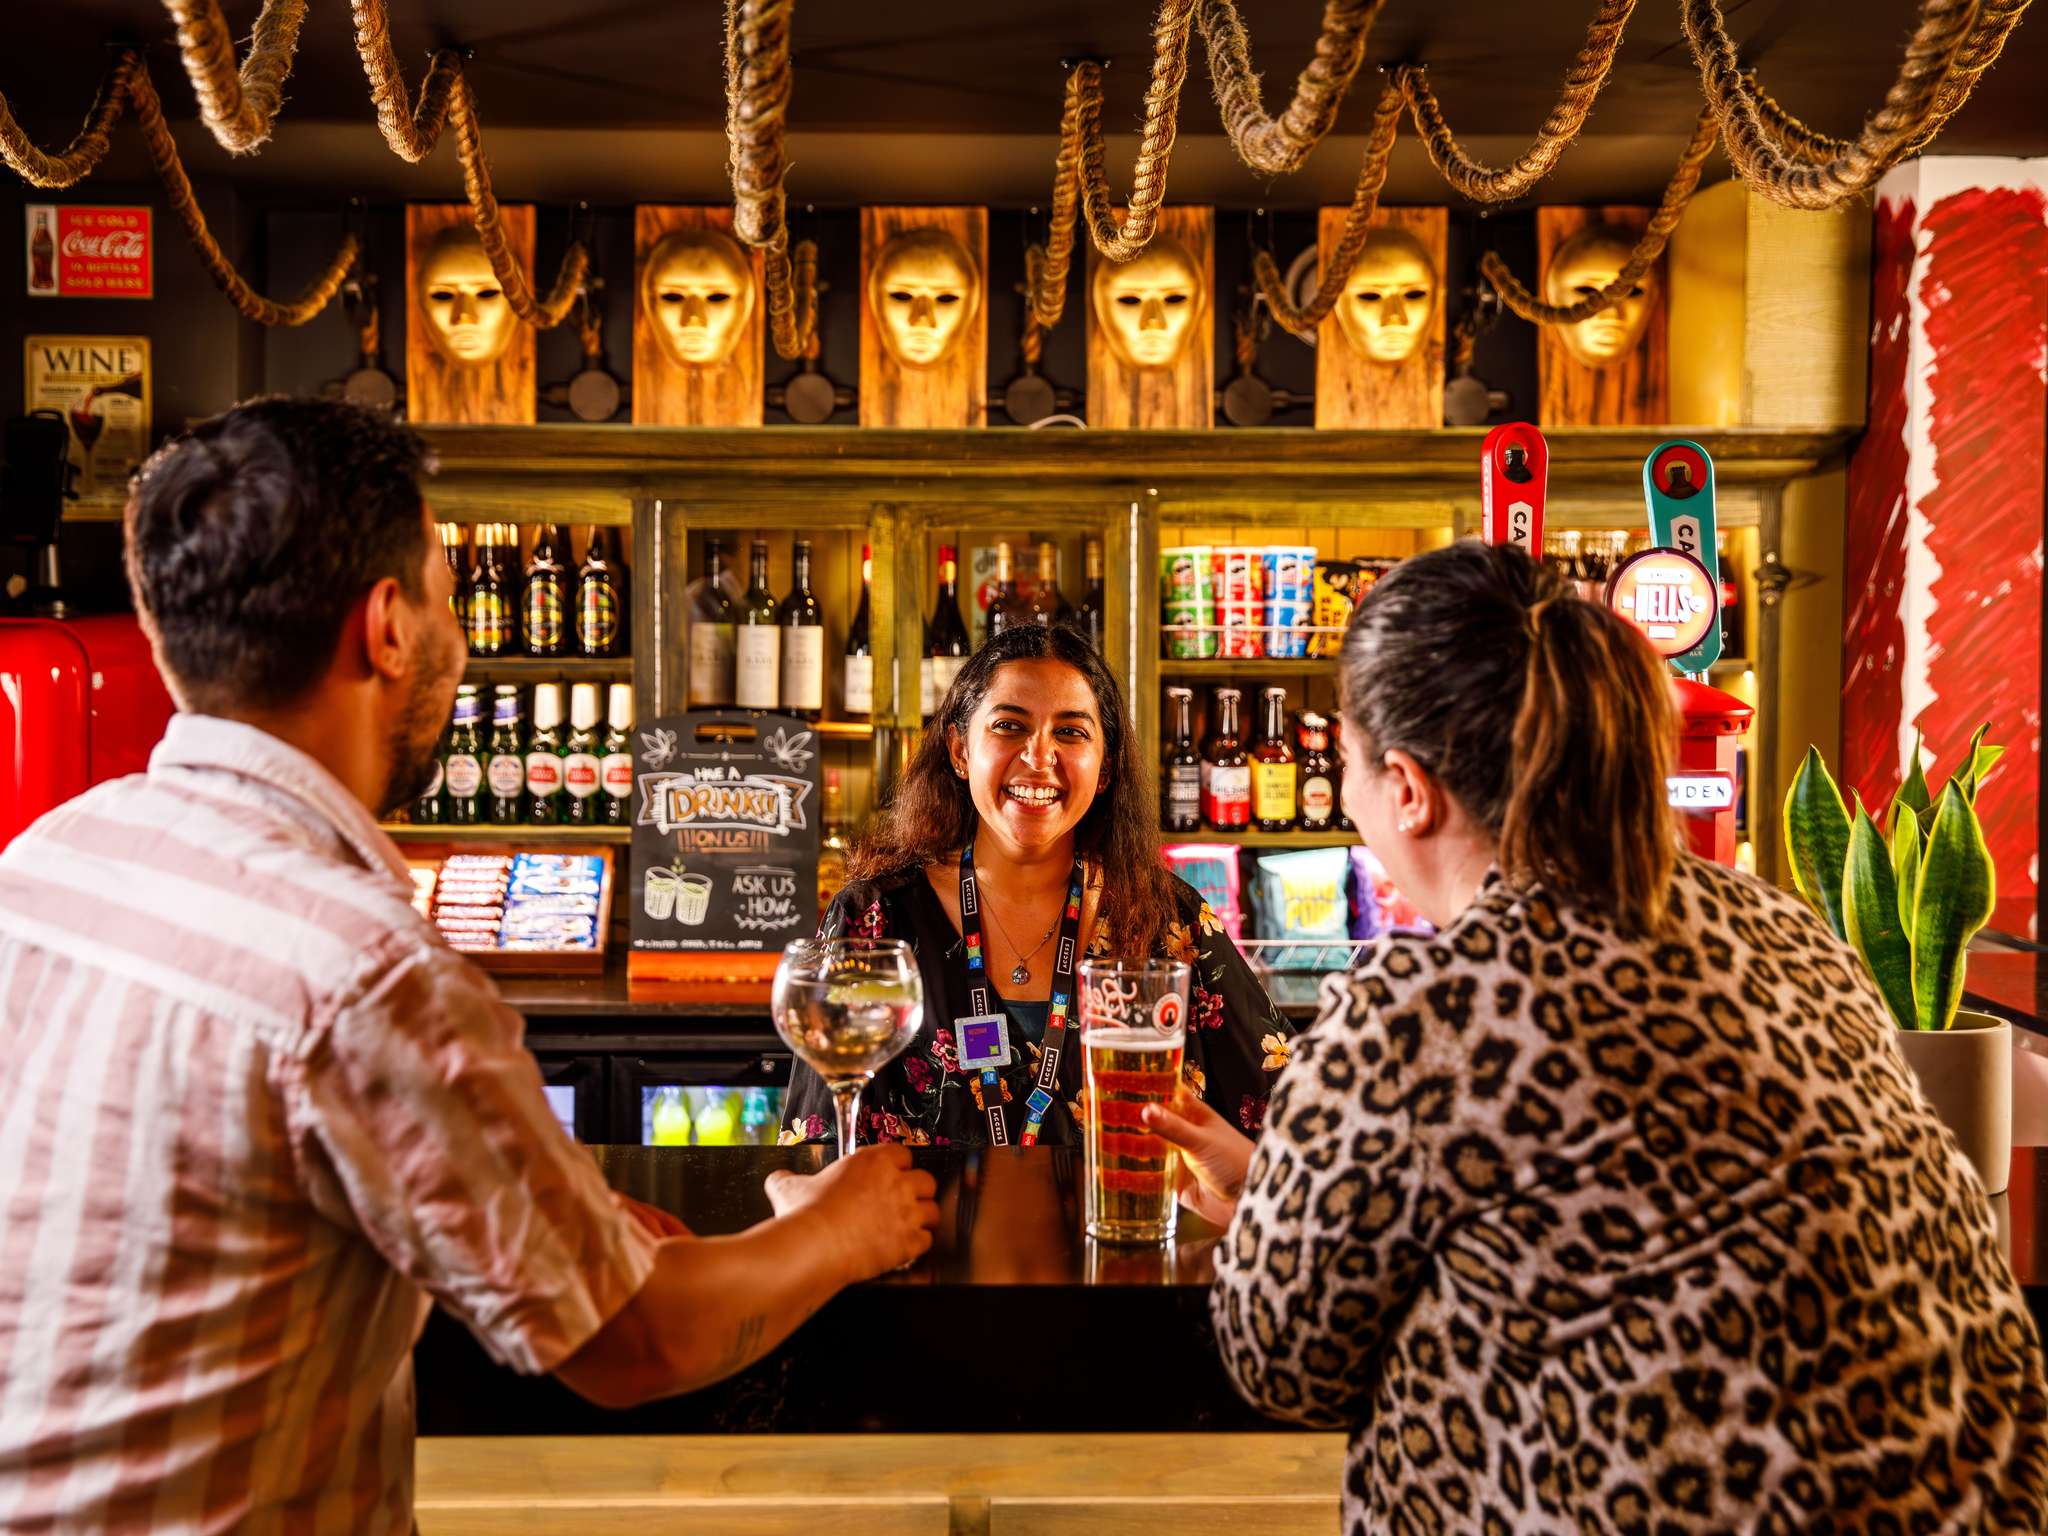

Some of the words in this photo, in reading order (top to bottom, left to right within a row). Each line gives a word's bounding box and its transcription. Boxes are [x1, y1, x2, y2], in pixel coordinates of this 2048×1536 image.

[43, 347, 134, 372] WINE
[732, 874, 768, 895] ASK
[771, 876, 796, 895] US
[964, 883, 973, 910] ACCESS
[1062, 941, 1071, 969] ACCESS
[1044, 1053, 1054, 1083] ACCESS
[993, 1112, 1003, 1141] ACCESS
